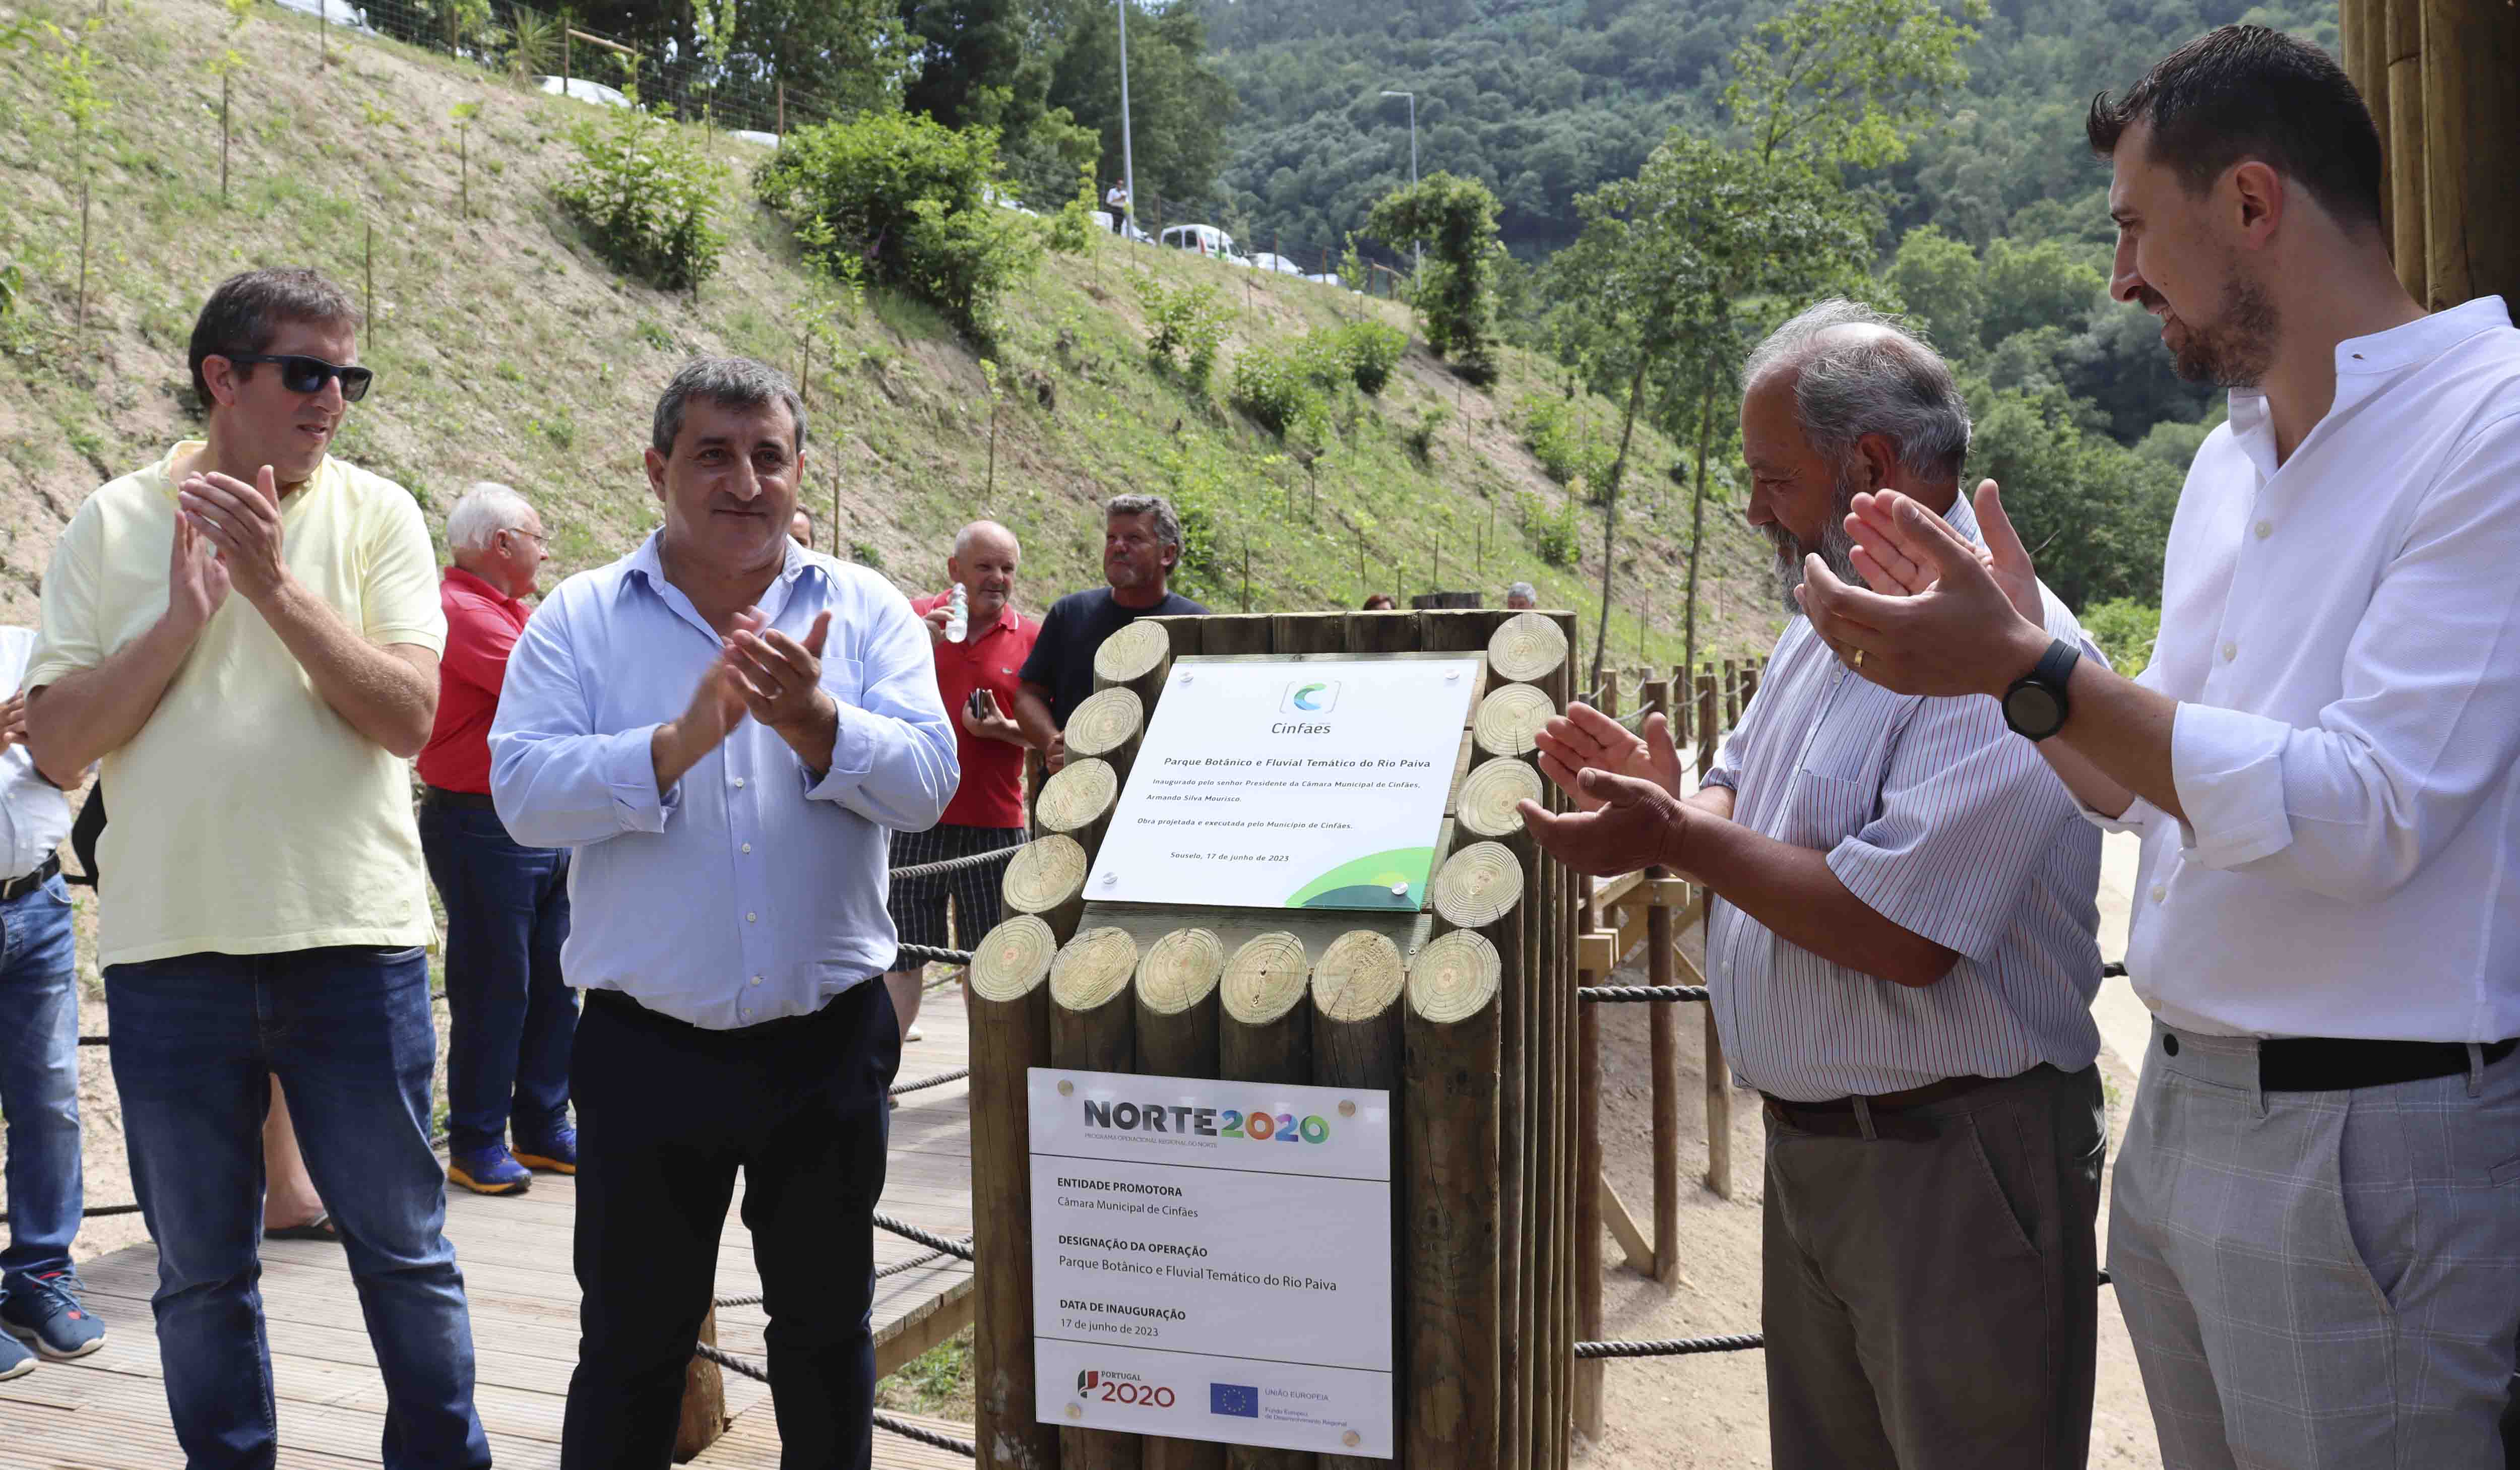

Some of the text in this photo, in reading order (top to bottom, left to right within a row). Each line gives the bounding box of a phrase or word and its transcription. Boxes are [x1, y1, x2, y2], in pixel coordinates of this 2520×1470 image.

[1164, 757, 1202, 768] Parque
[1205, 758, 1252, 766] Botânico
[1266, 758, 1303, 766] Fluvial
[1307, 759, 1356, 768] Temático
[1359, 759, 1373, 768] do
[1377, 759, 1396, 768] Rio
[1400, 759, 1431, 768] Paiva
[1157, 818, 1195, 826] projetada
[1246, 820, 1265, 828] pelo
[1266, 821, 1306, 829] Município
[1170, 852, 1203, 860] Souselo,
[1057, 1177, 1183, 1197] ENTIDADE PROMOTORA
[1057, 1196, 1198, 1218] Câmara Municipal de Cinfães
[1058, 1235, 1208, 1258] DESIGNAÇÃO DA OPERAÇÃO
[1059, 1254, 1337, 1291] Parque Botânico e Fluvial Temático do Rio Paiva
[1060, 1299, 1186, 1322] DATA DE INAUGURAÇÃO
[1061, 1318, 1159, 1337] 17 de junho de 2023
[1101, 1370, 1142, 1382] PORTUGAL
[1101, 1381, 1175, 1408] 2020
[1265, 1388, 1329, 1401] UNIÃO EUROPEIA
